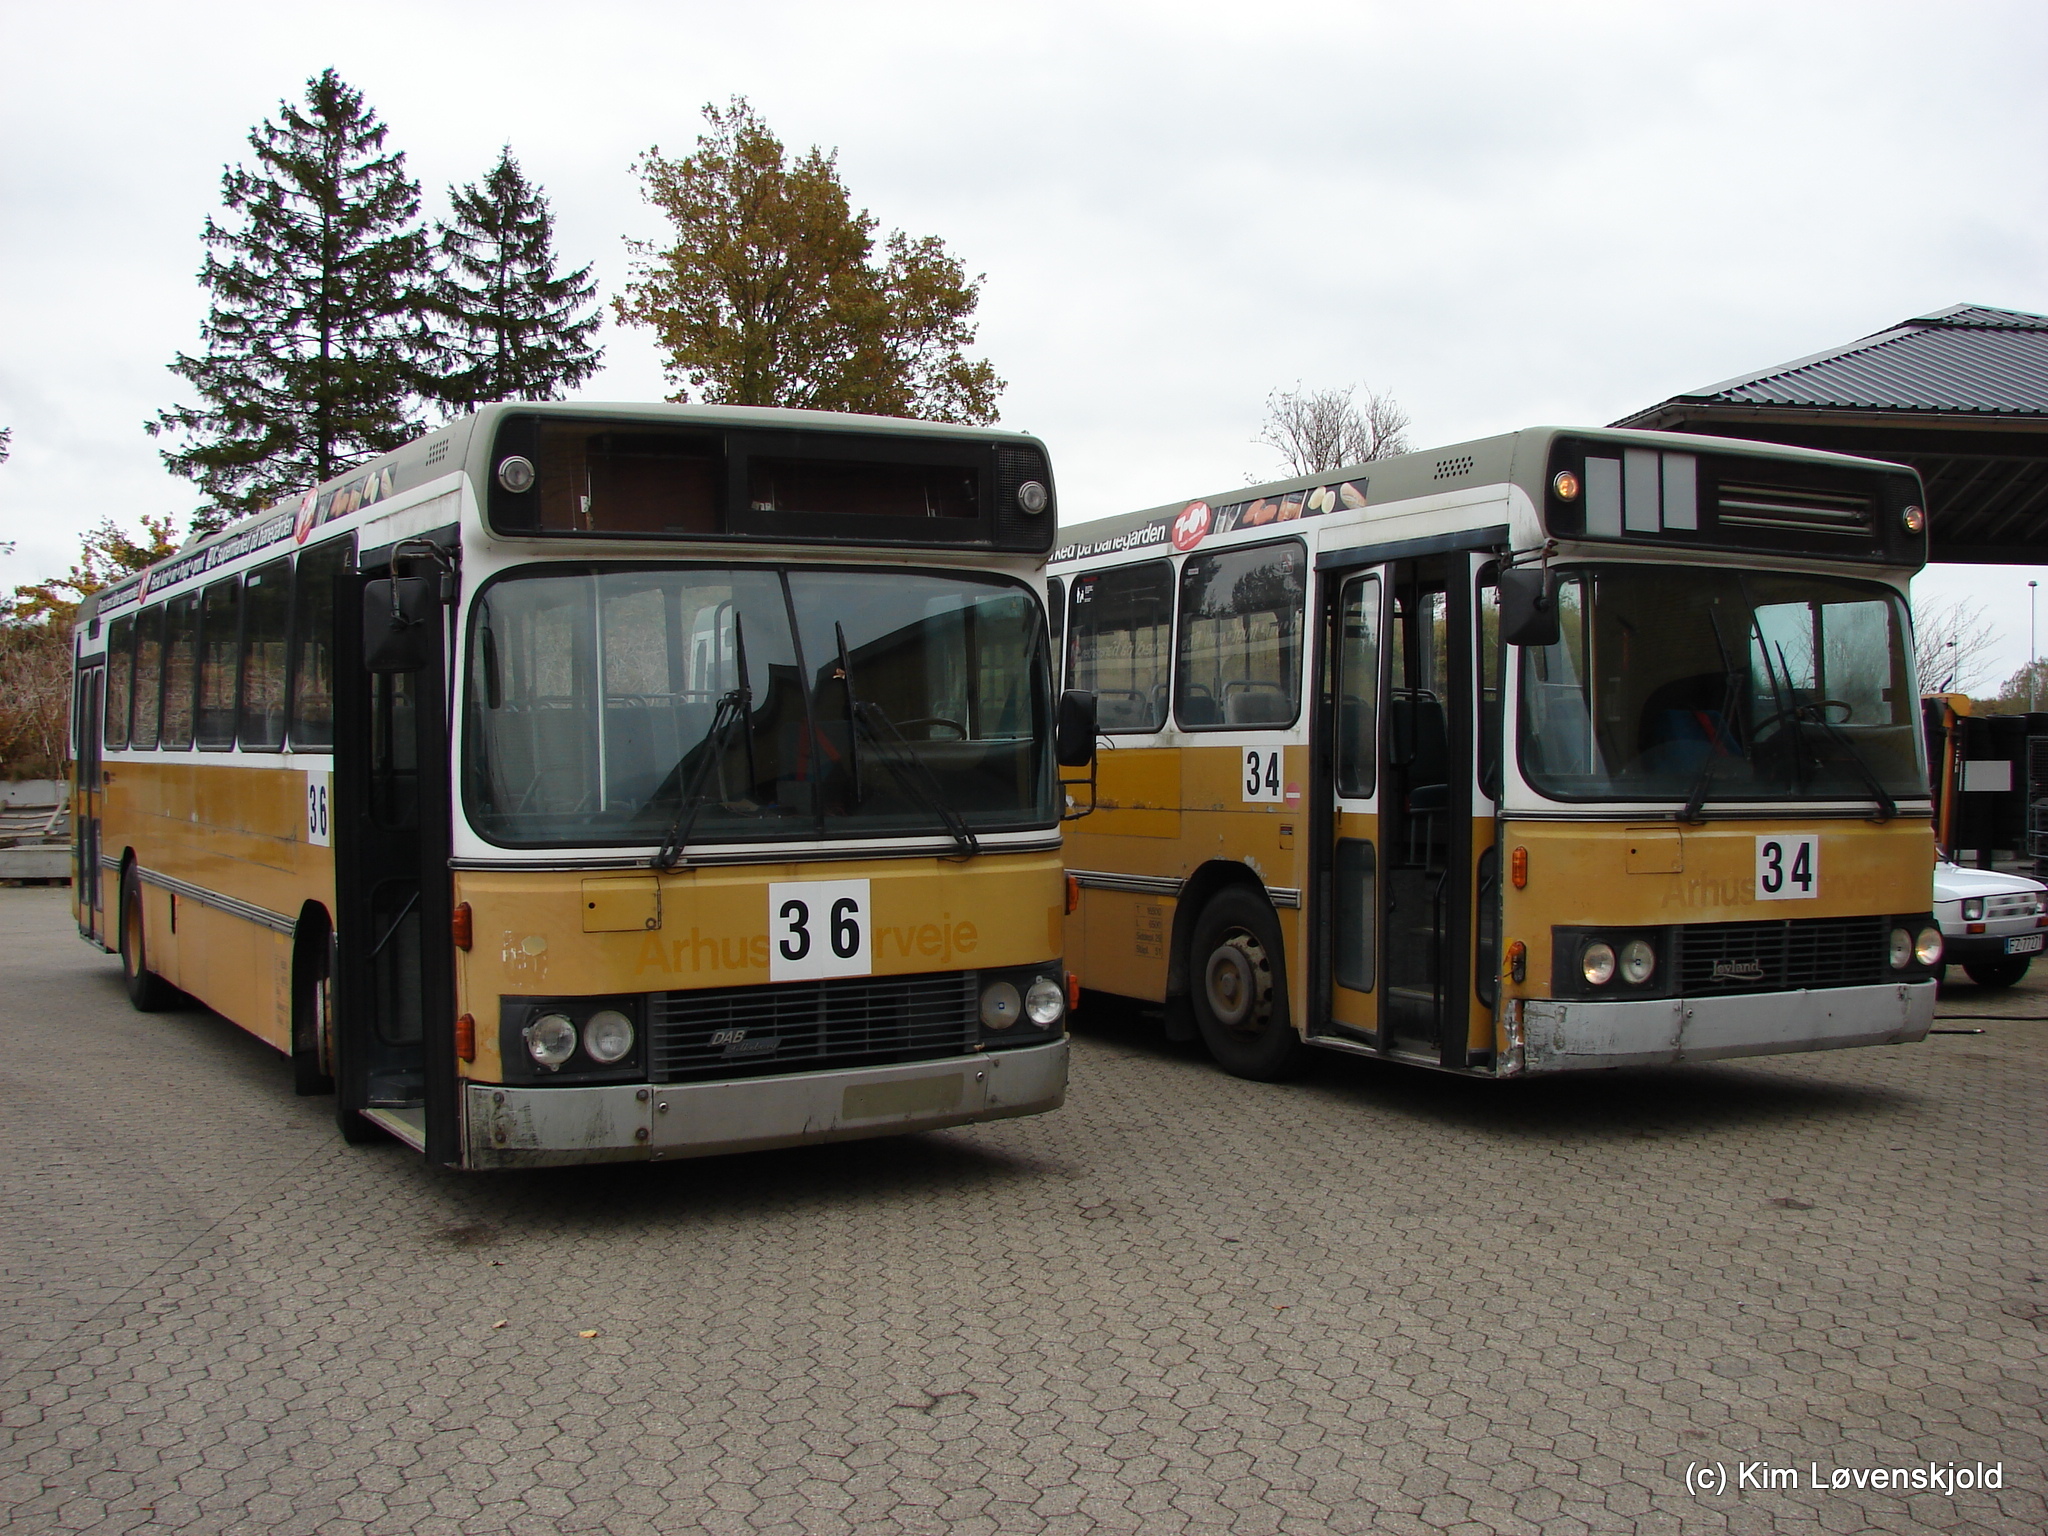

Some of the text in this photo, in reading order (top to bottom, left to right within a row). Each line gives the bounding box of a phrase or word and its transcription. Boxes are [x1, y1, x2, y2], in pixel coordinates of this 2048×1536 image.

[1247, 751, 1279, 796] 34
[309, 784, 328, 836] 36
[1762, 842, 1812, 893] 34
[779, 897, 860, 961] 36
[711, 1030, 746, 1046] DAB
